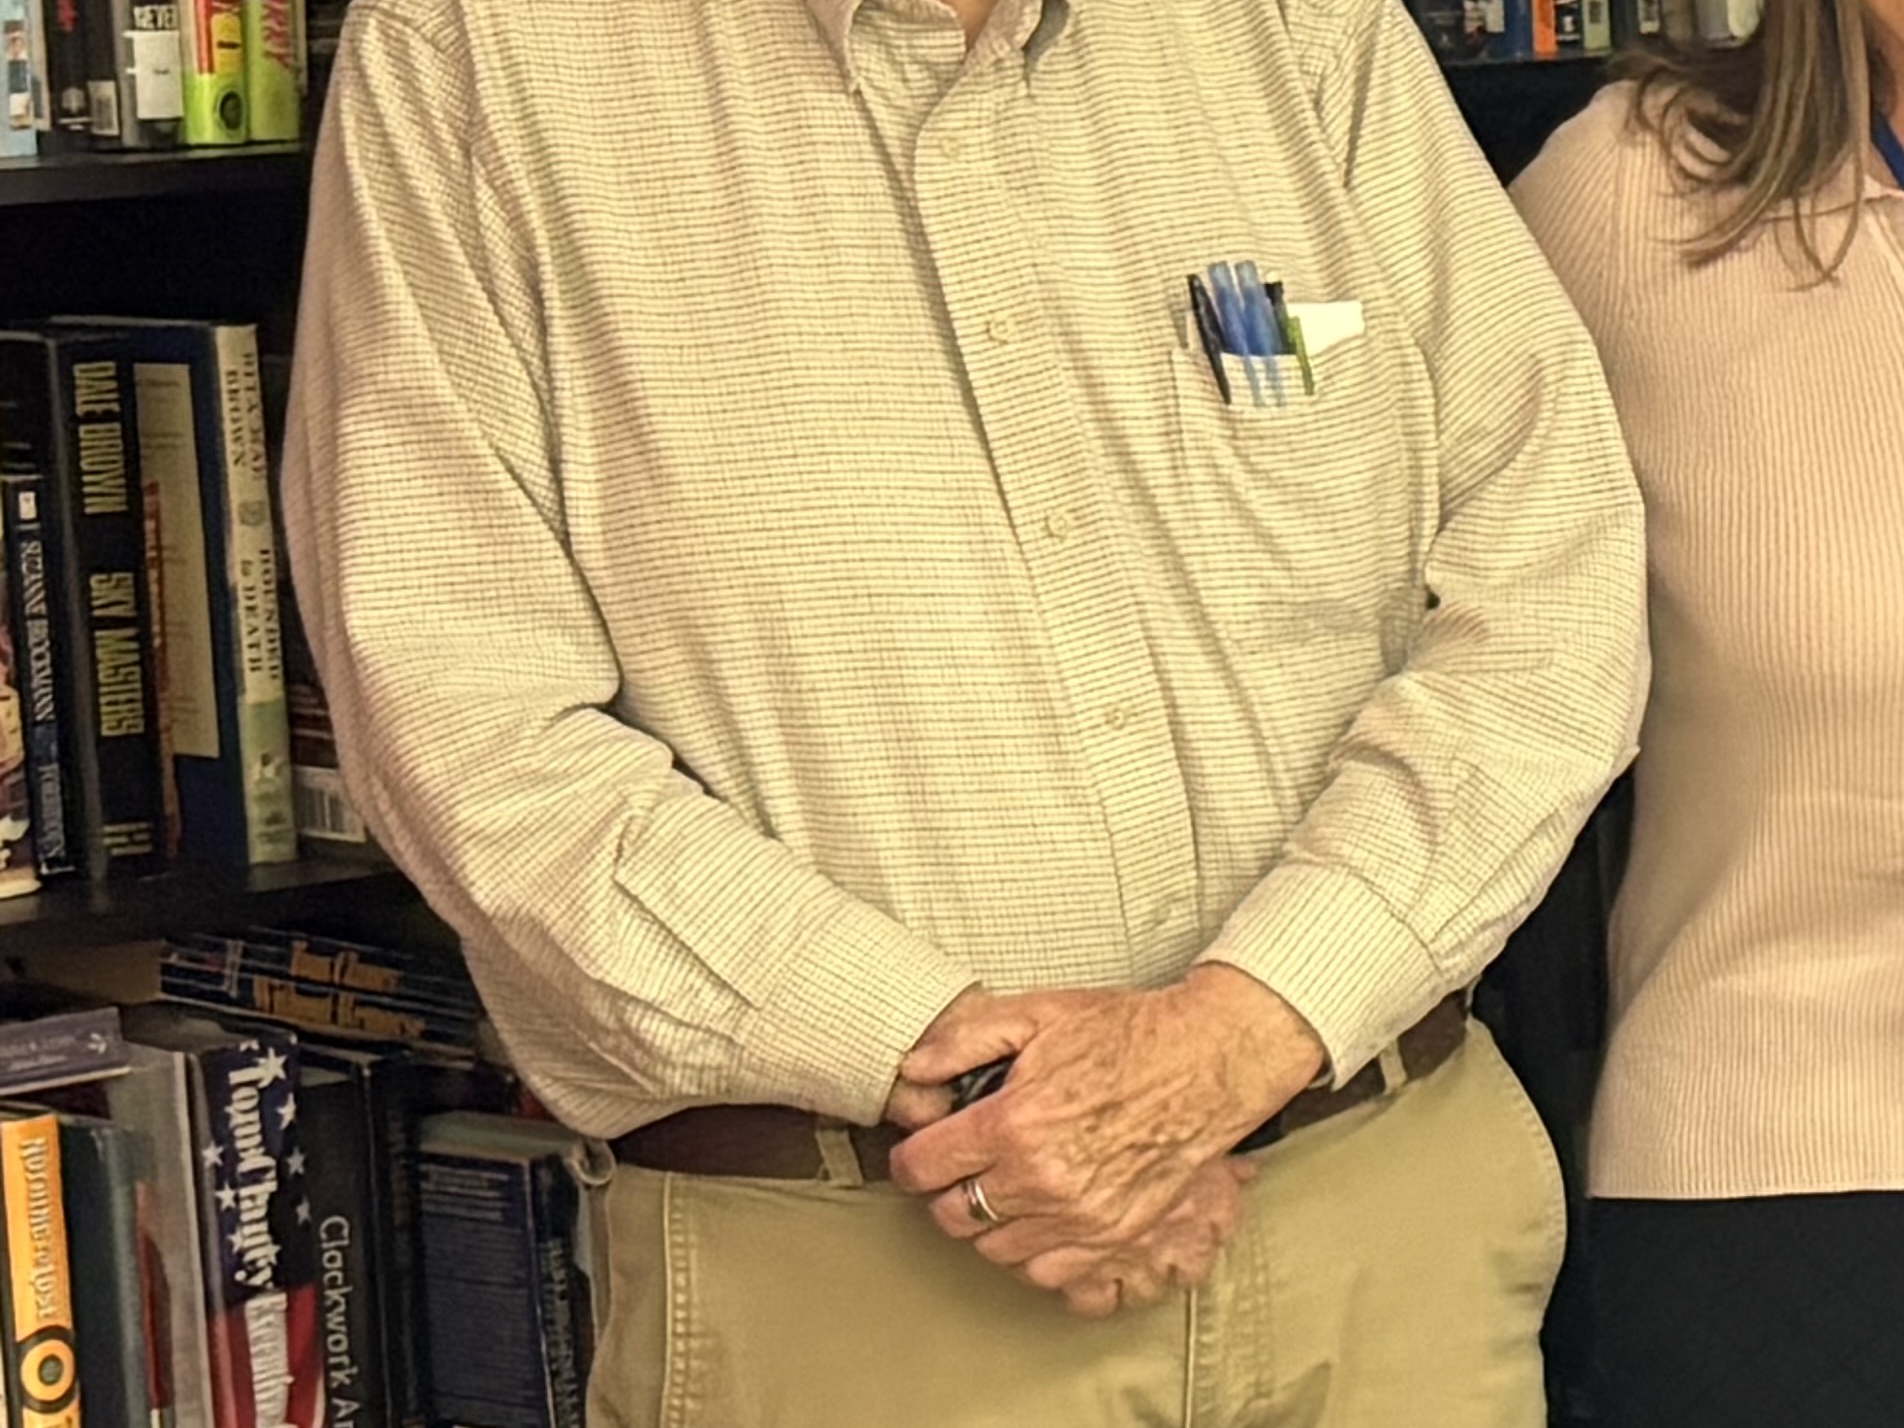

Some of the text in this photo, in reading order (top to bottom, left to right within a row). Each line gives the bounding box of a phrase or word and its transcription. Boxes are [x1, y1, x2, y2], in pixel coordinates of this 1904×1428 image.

[226, 366, 248, 470] BROWN
[73, 361, 146, 737] DALE BROWN SKY MASTERS
[243, 584, 264, 675] DEATH
[226, 1062, 295, 1415] Tom Clancy Executive
[318, 1214, 357, 1388] Clockwork
